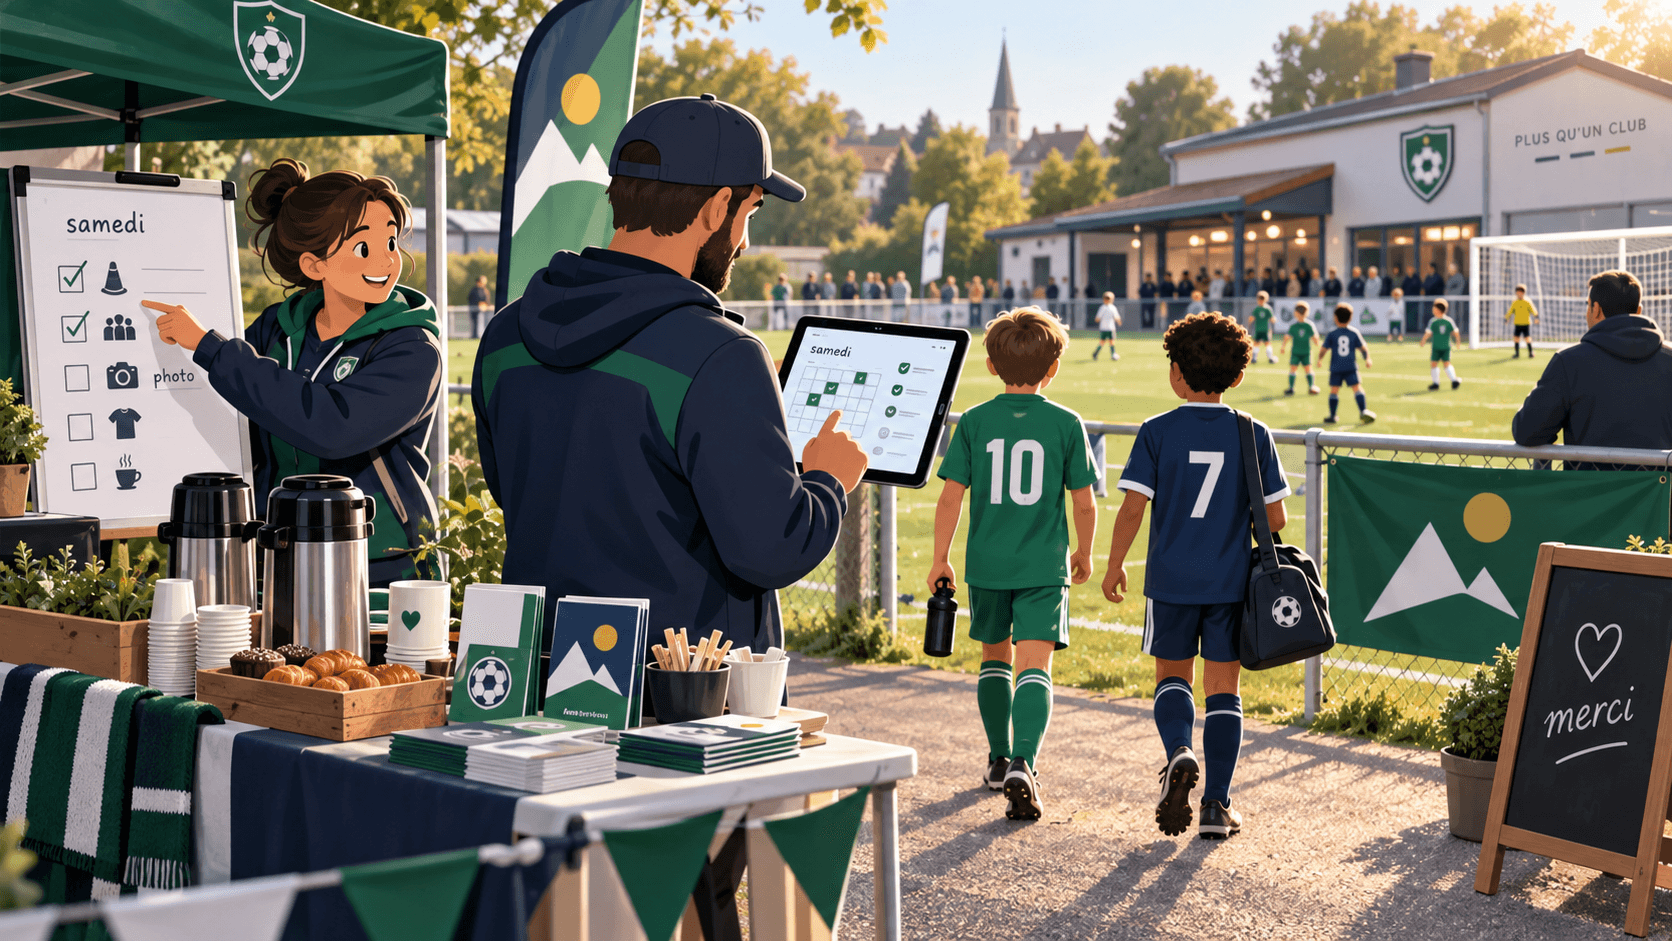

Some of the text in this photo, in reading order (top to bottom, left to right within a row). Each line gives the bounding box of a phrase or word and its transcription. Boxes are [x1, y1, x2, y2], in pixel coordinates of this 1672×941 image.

[1515, 118, 1647, 147] PLUS QU'UN CLUB
[67, 211, 145, 234] samedi
[810, 345, 852, 358] samedi
[1337, 335, 1350, 357] 8
[154, 368, 195, 389] photo
[986, 438, 1045, 506] 10
[1188, 450, 1225, 519] 7
[1543, 685, 1635, 738] merci
